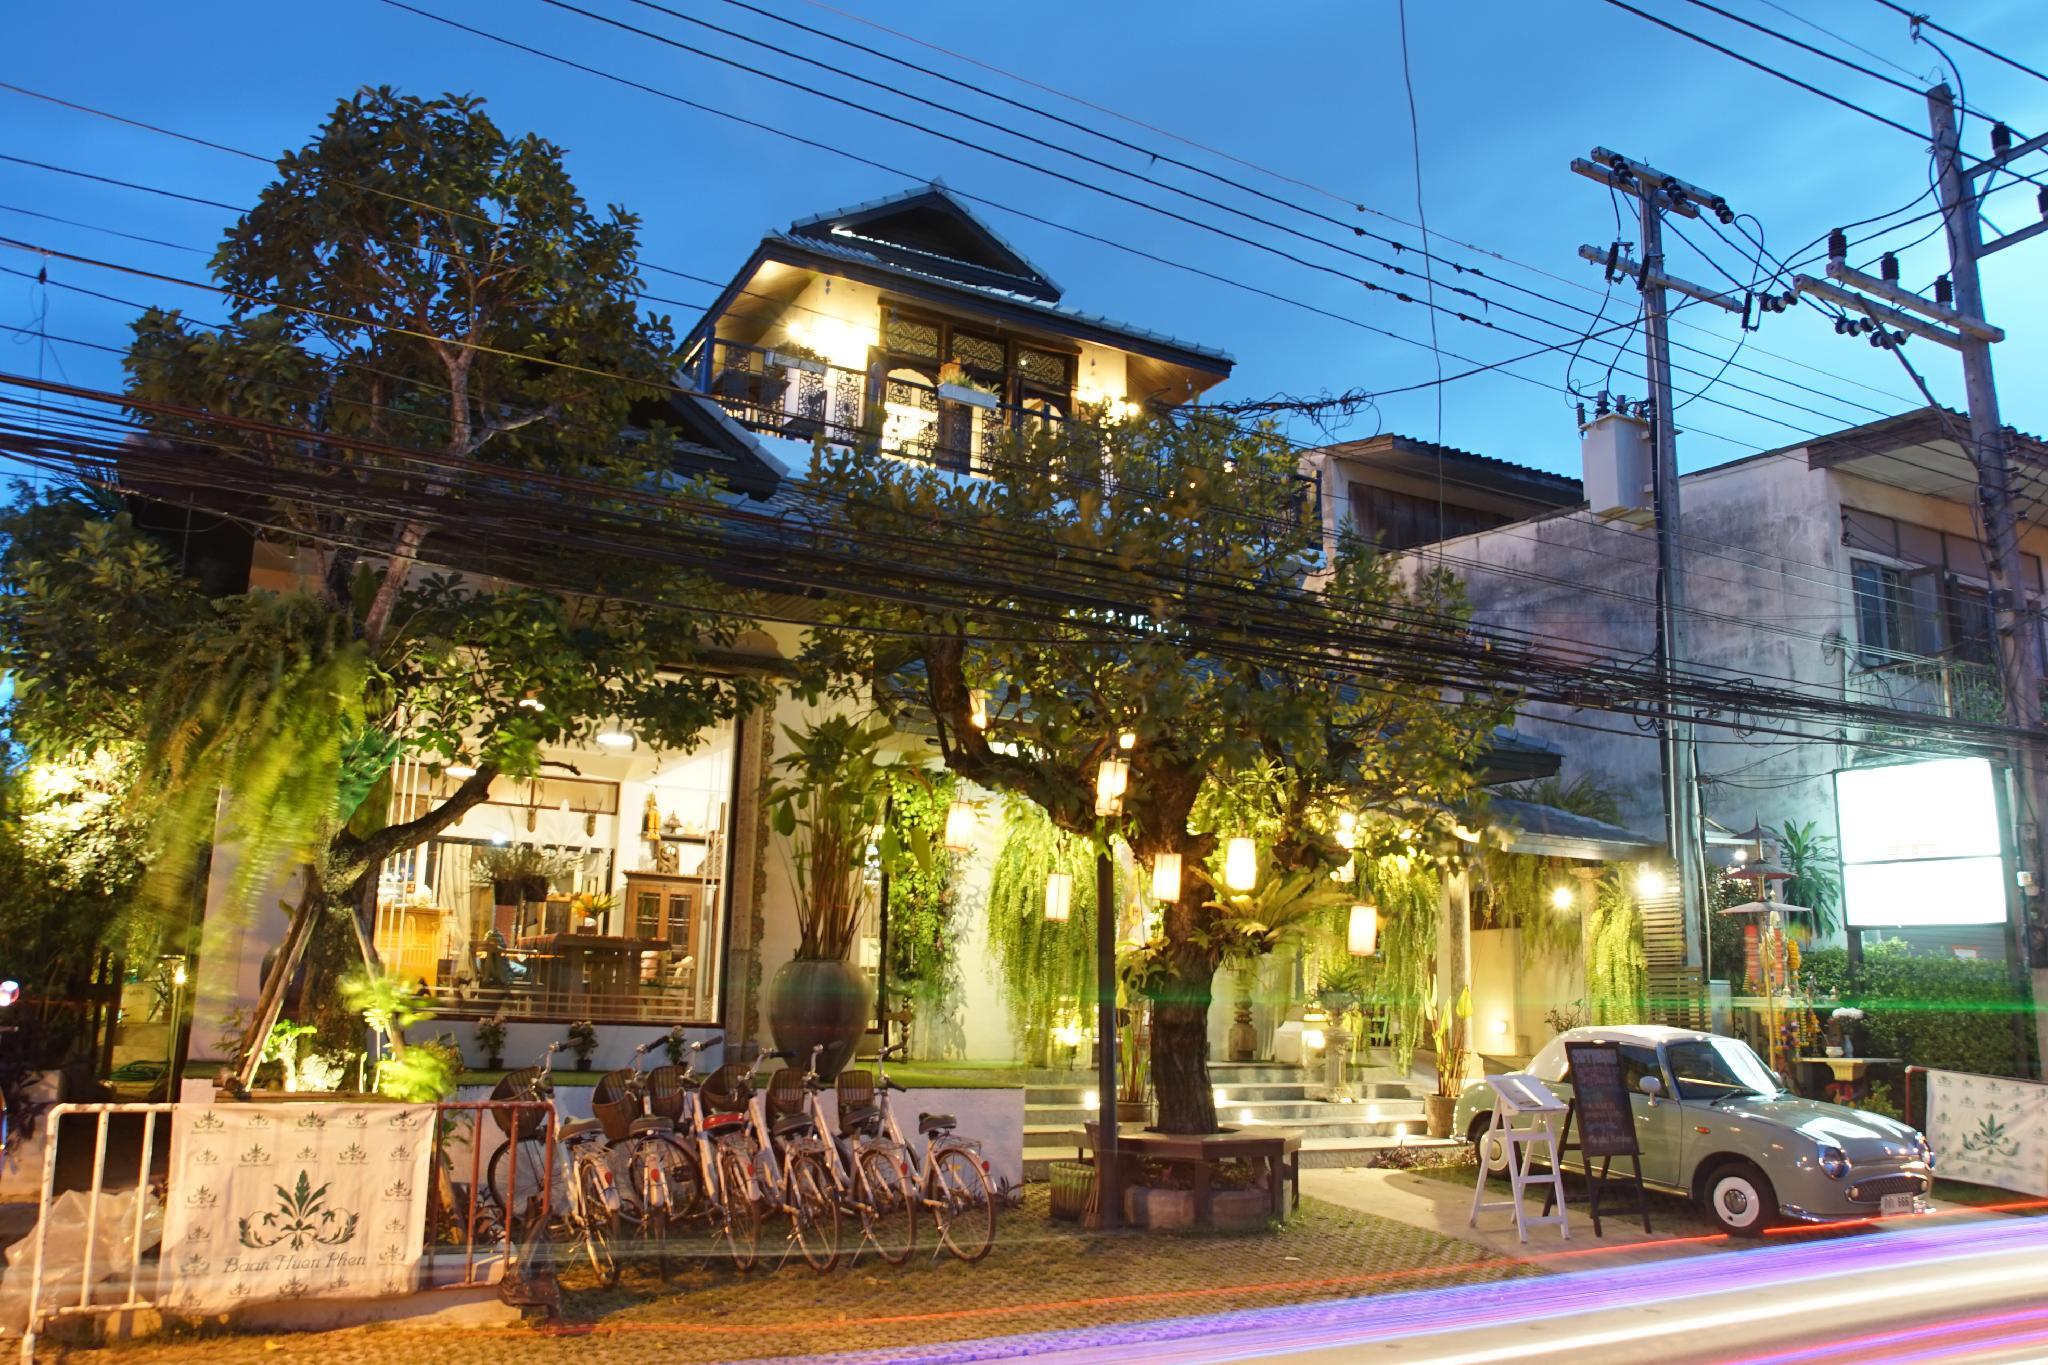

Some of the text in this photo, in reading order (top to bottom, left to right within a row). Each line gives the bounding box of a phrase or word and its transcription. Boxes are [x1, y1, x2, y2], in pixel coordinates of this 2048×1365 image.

[223, 1251, 367, 1273] Baan Huen Phen
